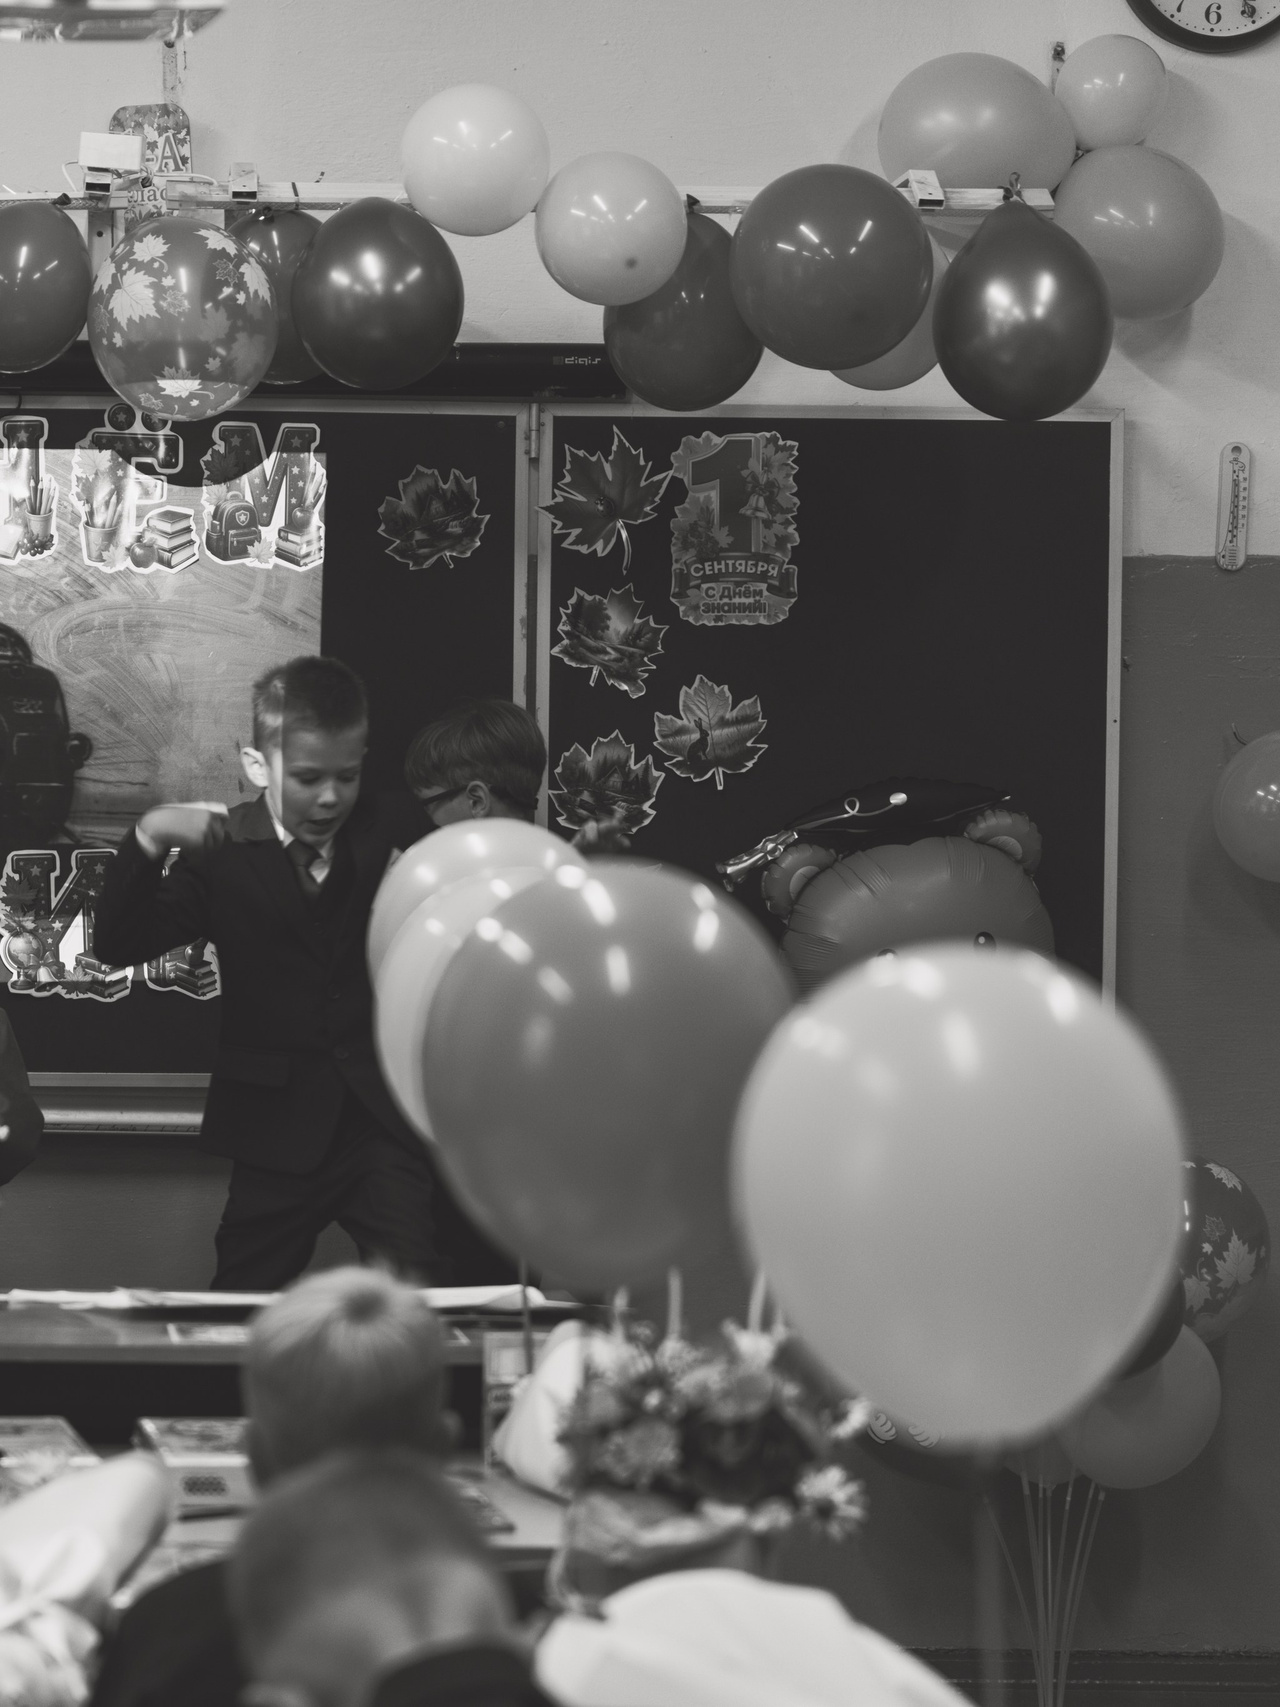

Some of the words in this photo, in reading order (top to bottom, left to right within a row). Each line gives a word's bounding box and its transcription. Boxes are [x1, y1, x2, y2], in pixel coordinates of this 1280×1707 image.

[1205, 2, 1222, 25] 6
[565, 356, 601, 366] digis
[690, 560, 779, 577] СЕНТЯБРЯ
[704, 586, 717, 599] С
